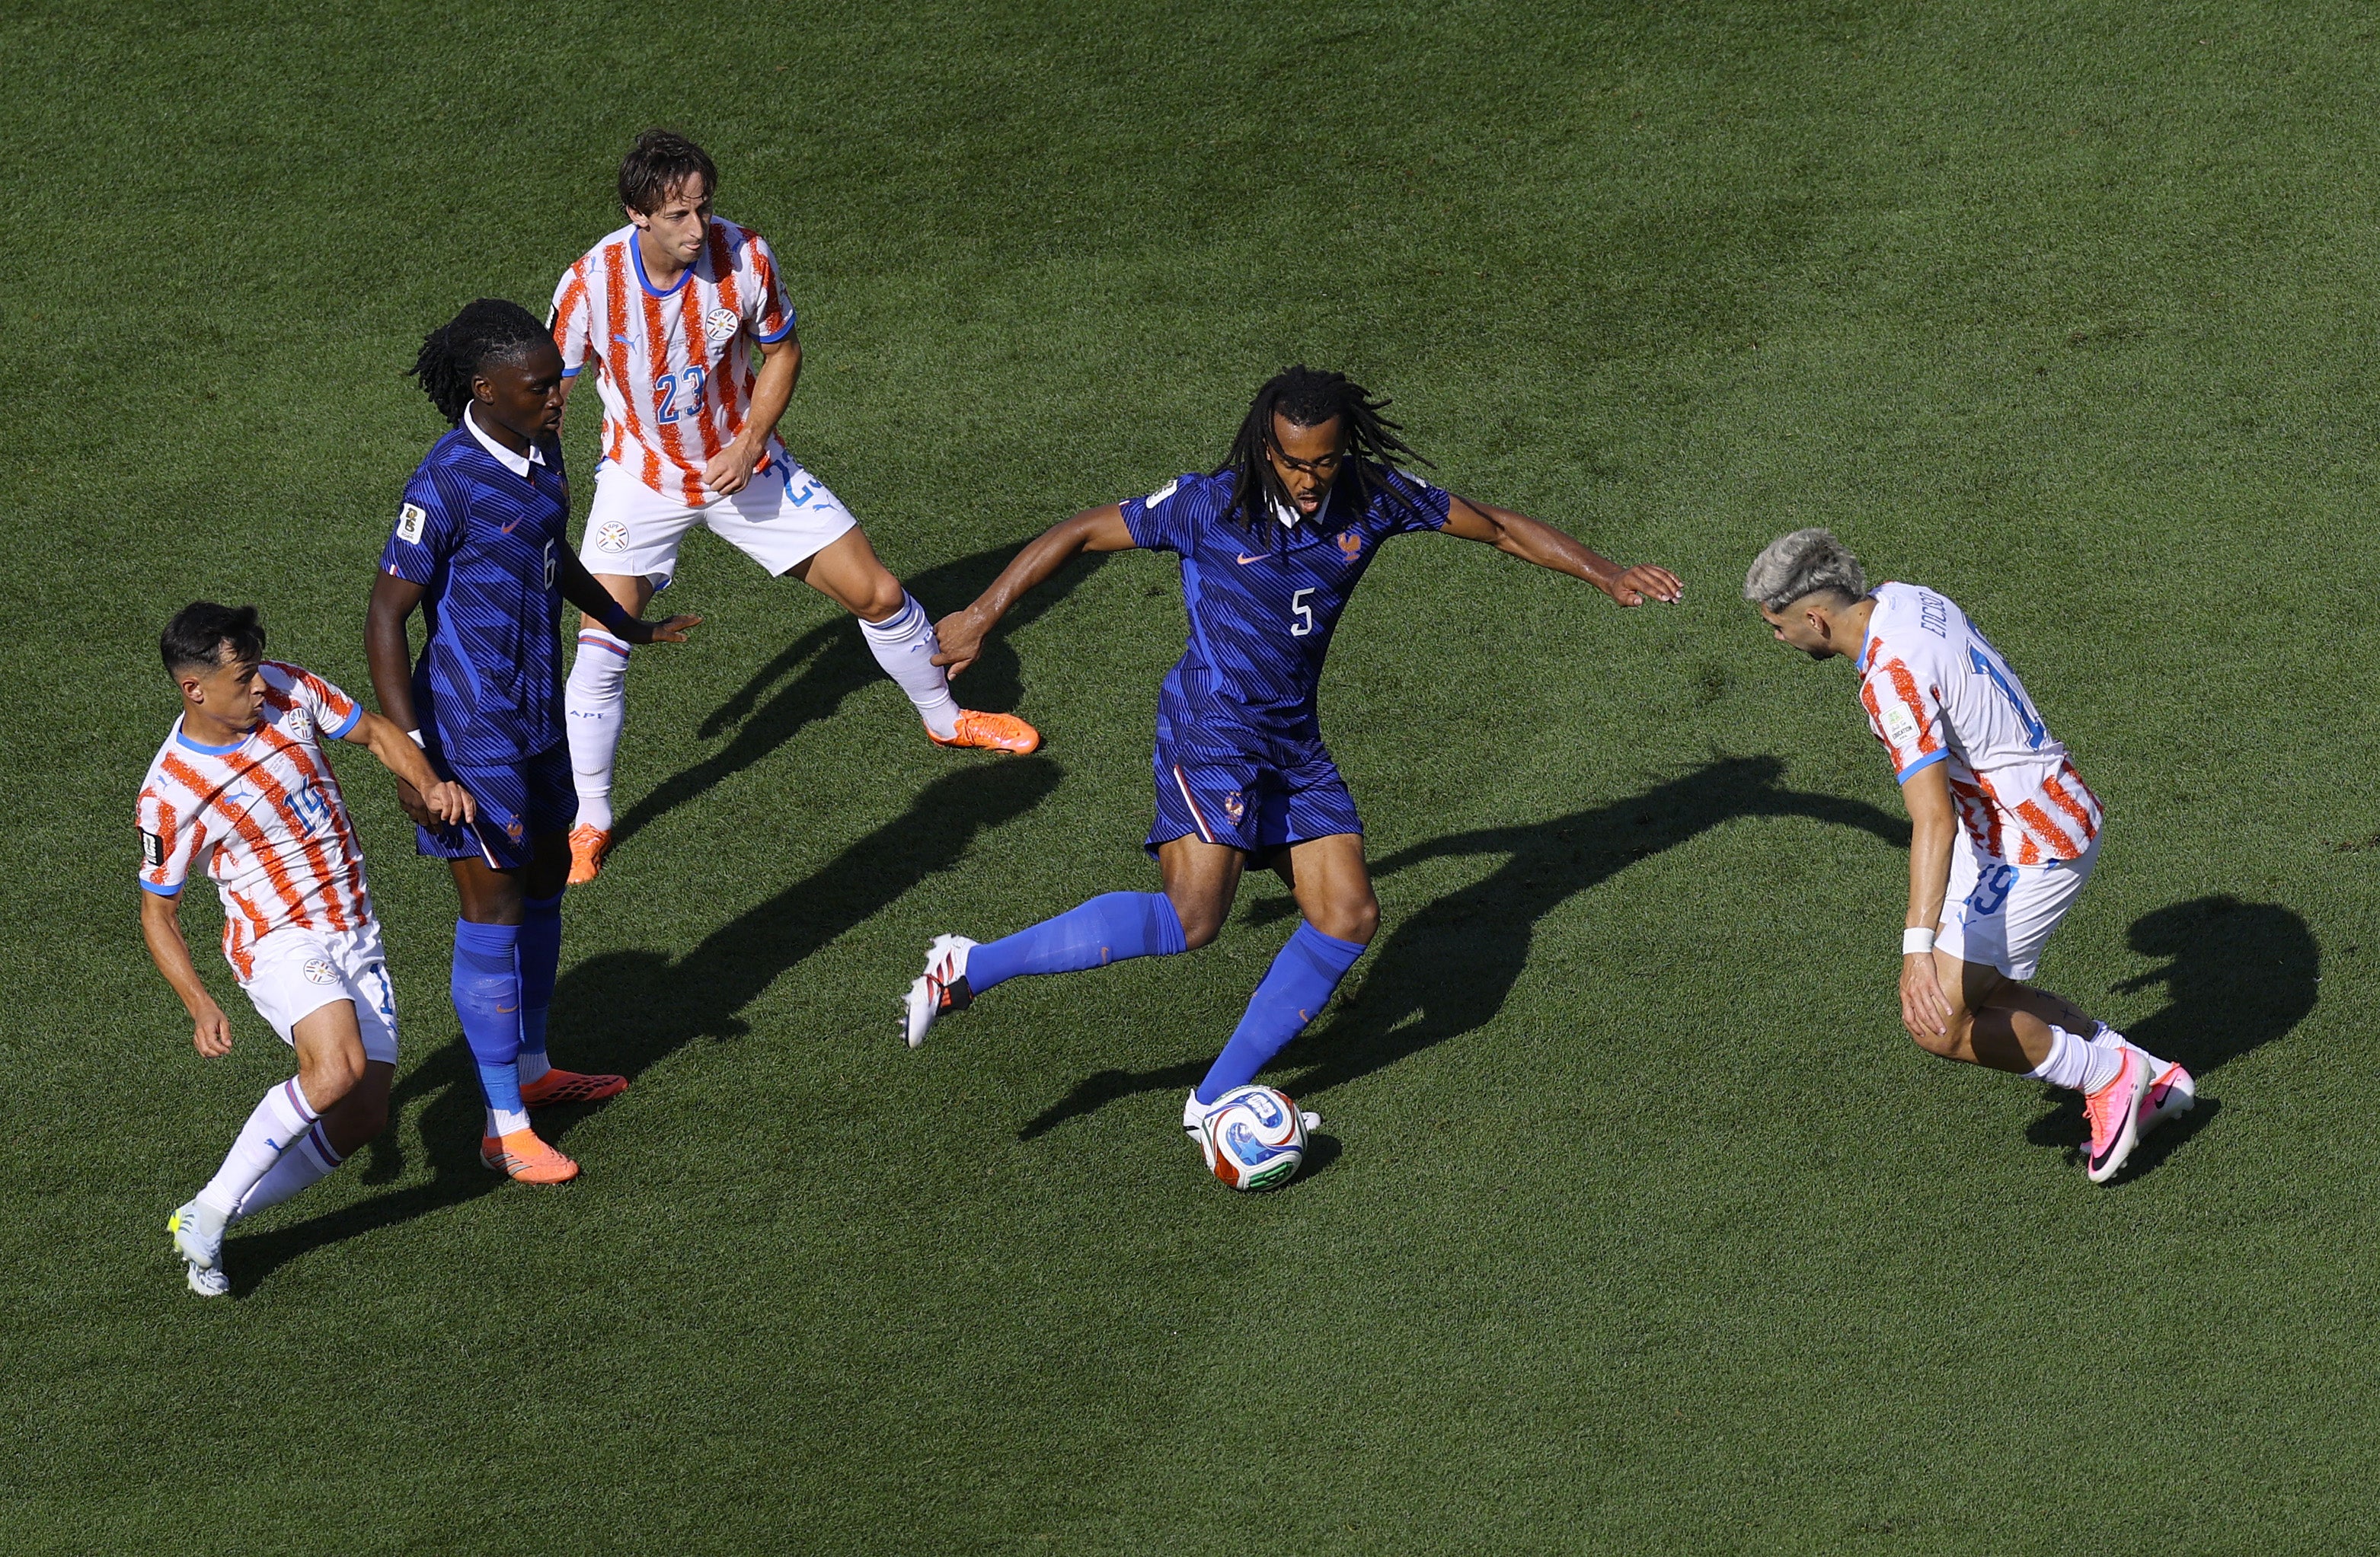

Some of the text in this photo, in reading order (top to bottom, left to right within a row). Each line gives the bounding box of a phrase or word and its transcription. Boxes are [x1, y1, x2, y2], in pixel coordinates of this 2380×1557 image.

[656, 365, 706, 425] 23
[543, 537, 556, 591] 6
[1290, 587, 1315, 637] 5
[1918, 591, 1947, 639] ENCISO
[283, 773, 331, 840] 14
